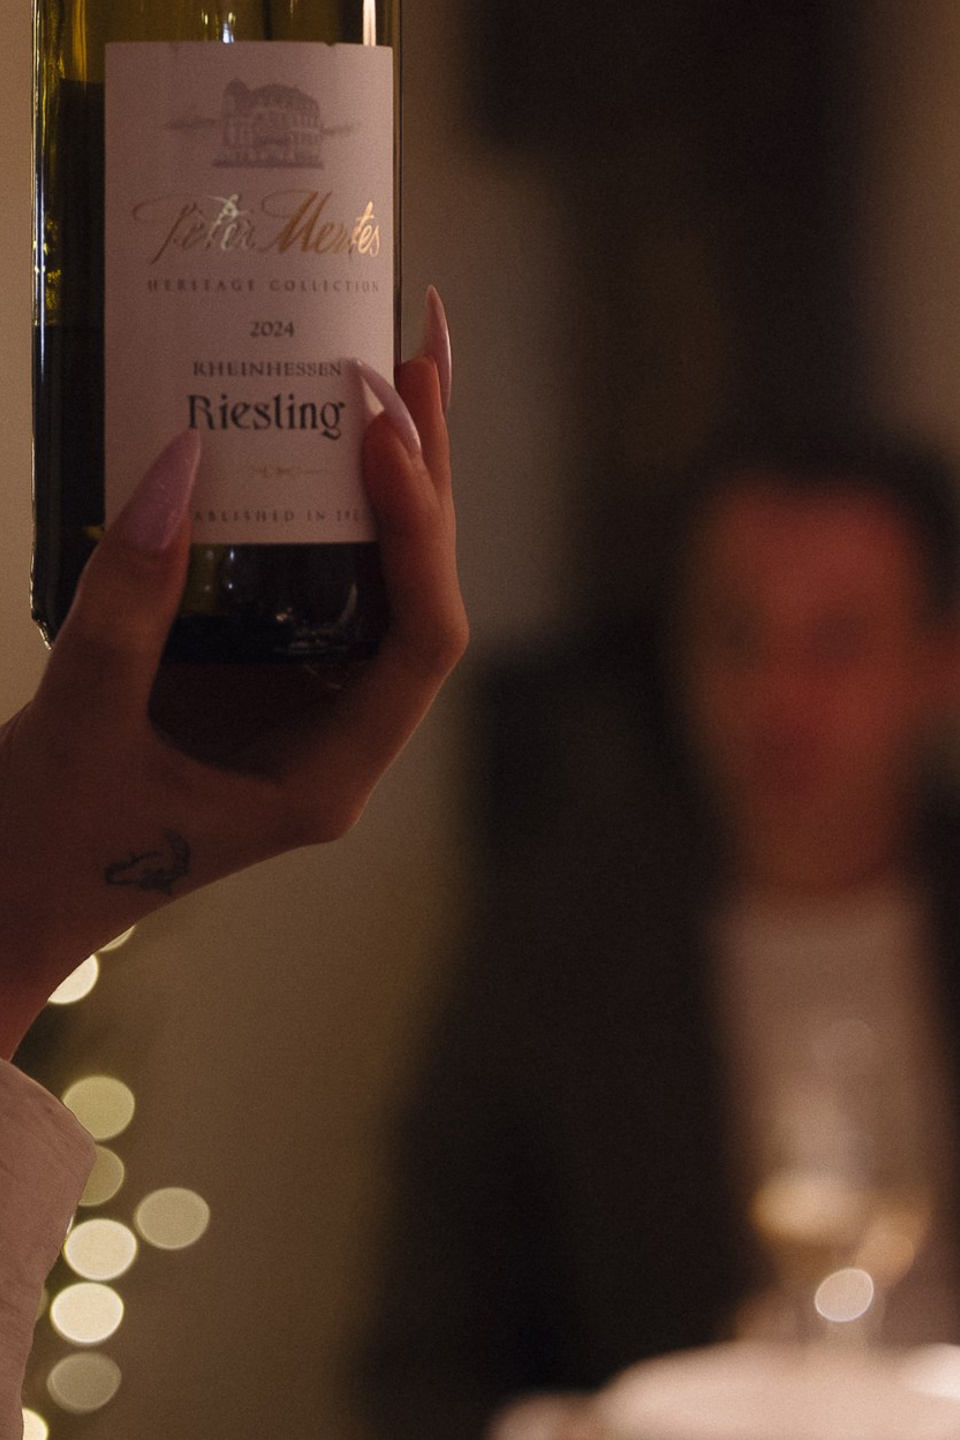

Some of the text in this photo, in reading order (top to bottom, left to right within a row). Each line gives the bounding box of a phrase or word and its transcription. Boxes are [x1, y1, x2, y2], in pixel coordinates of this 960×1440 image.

[132, 189, 381, 266] Peter Mertes
[147, 278, 380, 293] HERITAGE COLLECTION
[249, 321, 296, 338] 2024
[193, 360, 342, 377] RHEINHESSEN
[187, 393, 346, 441] Riesling
[307, 510, 326, 522] IN
